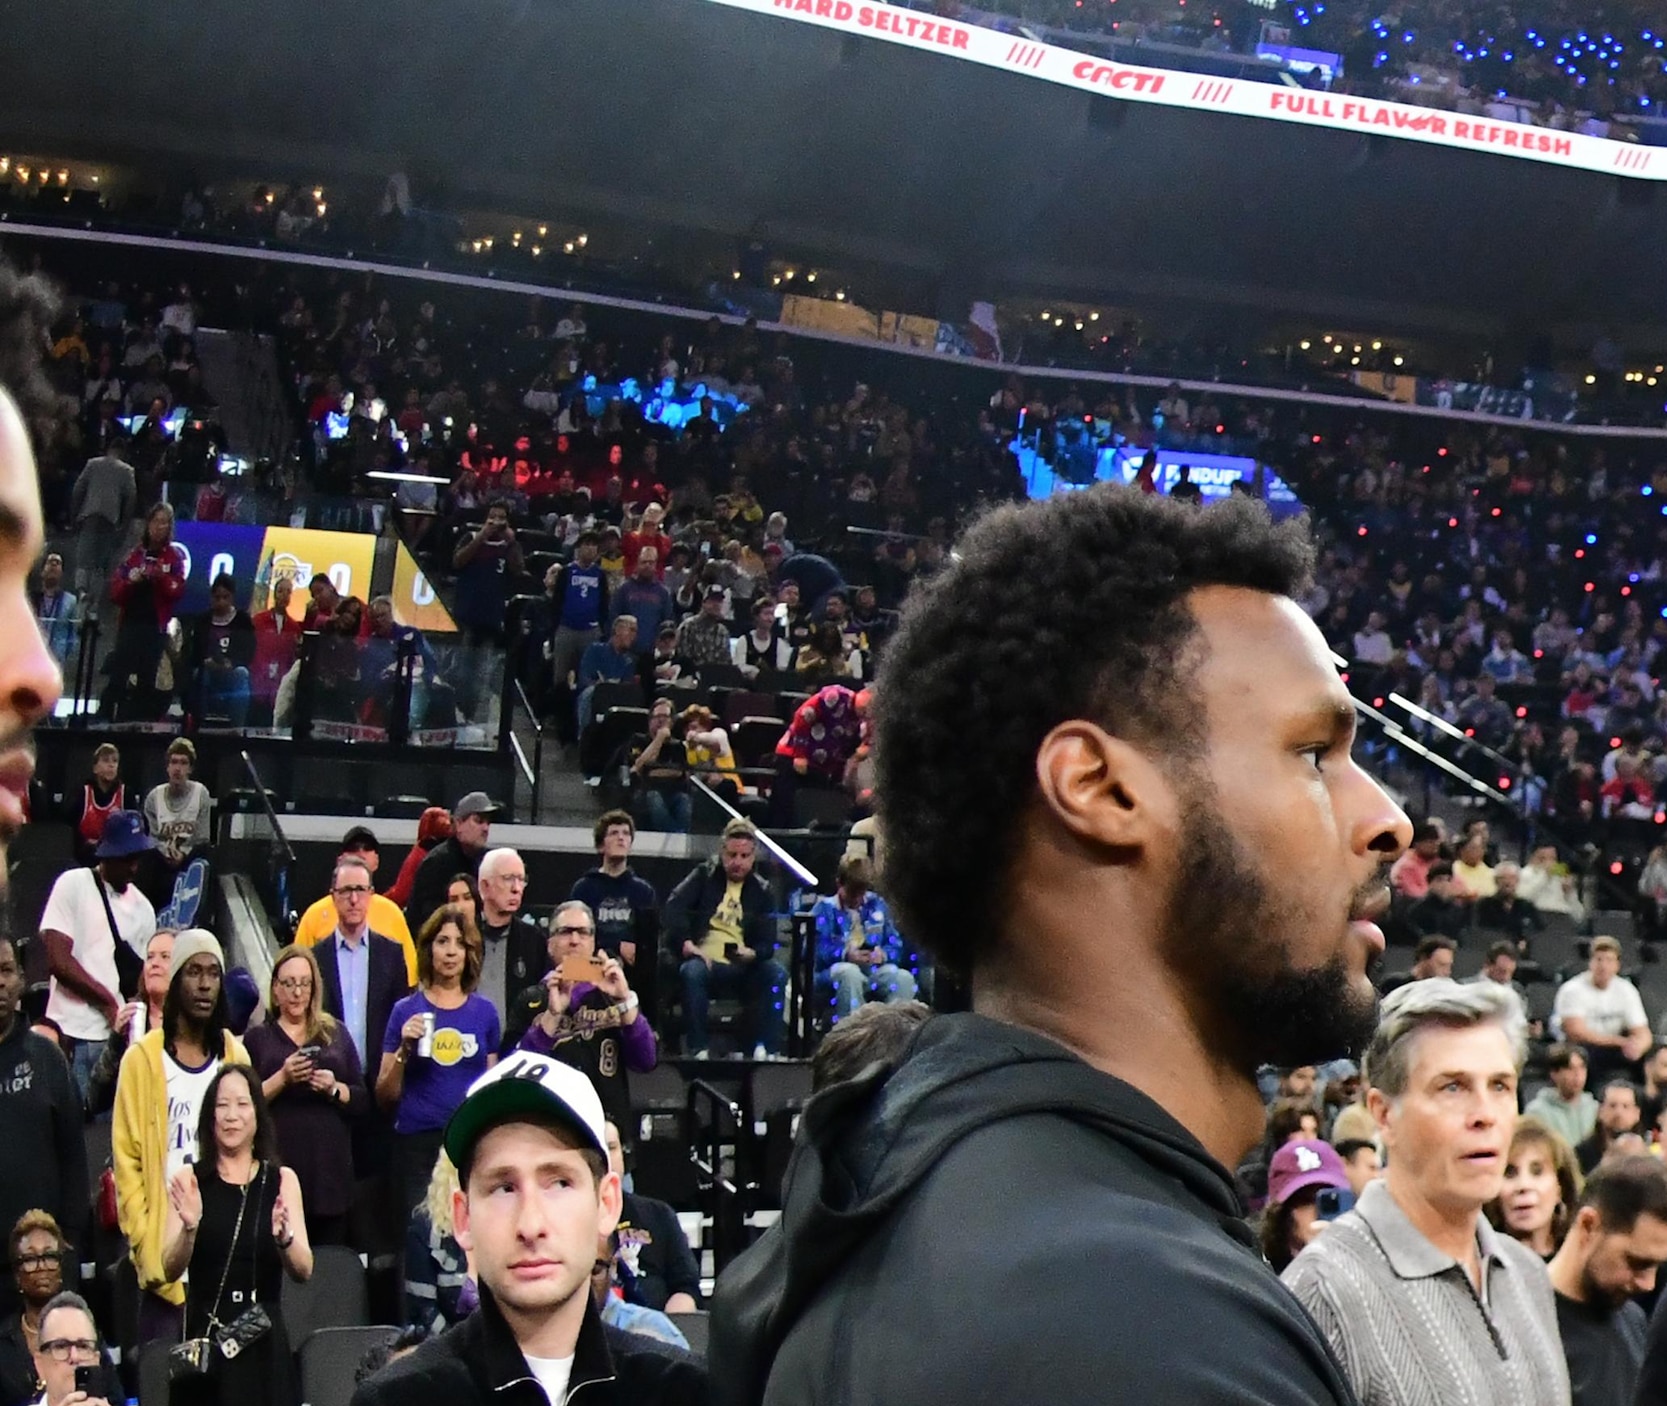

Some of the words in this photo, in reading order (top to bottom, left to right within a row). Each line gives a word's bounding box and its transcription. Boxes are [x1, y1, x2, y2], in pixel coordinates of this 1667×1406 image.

[858, 7, 970, 50] SELTZER
[1072, 61, 1166, 94] CACTI
[1270, 92, 1335, 118] FULL
[1454, 121, 1572, 157] REFRESH
[599, 1037, 619, 1072] 8
